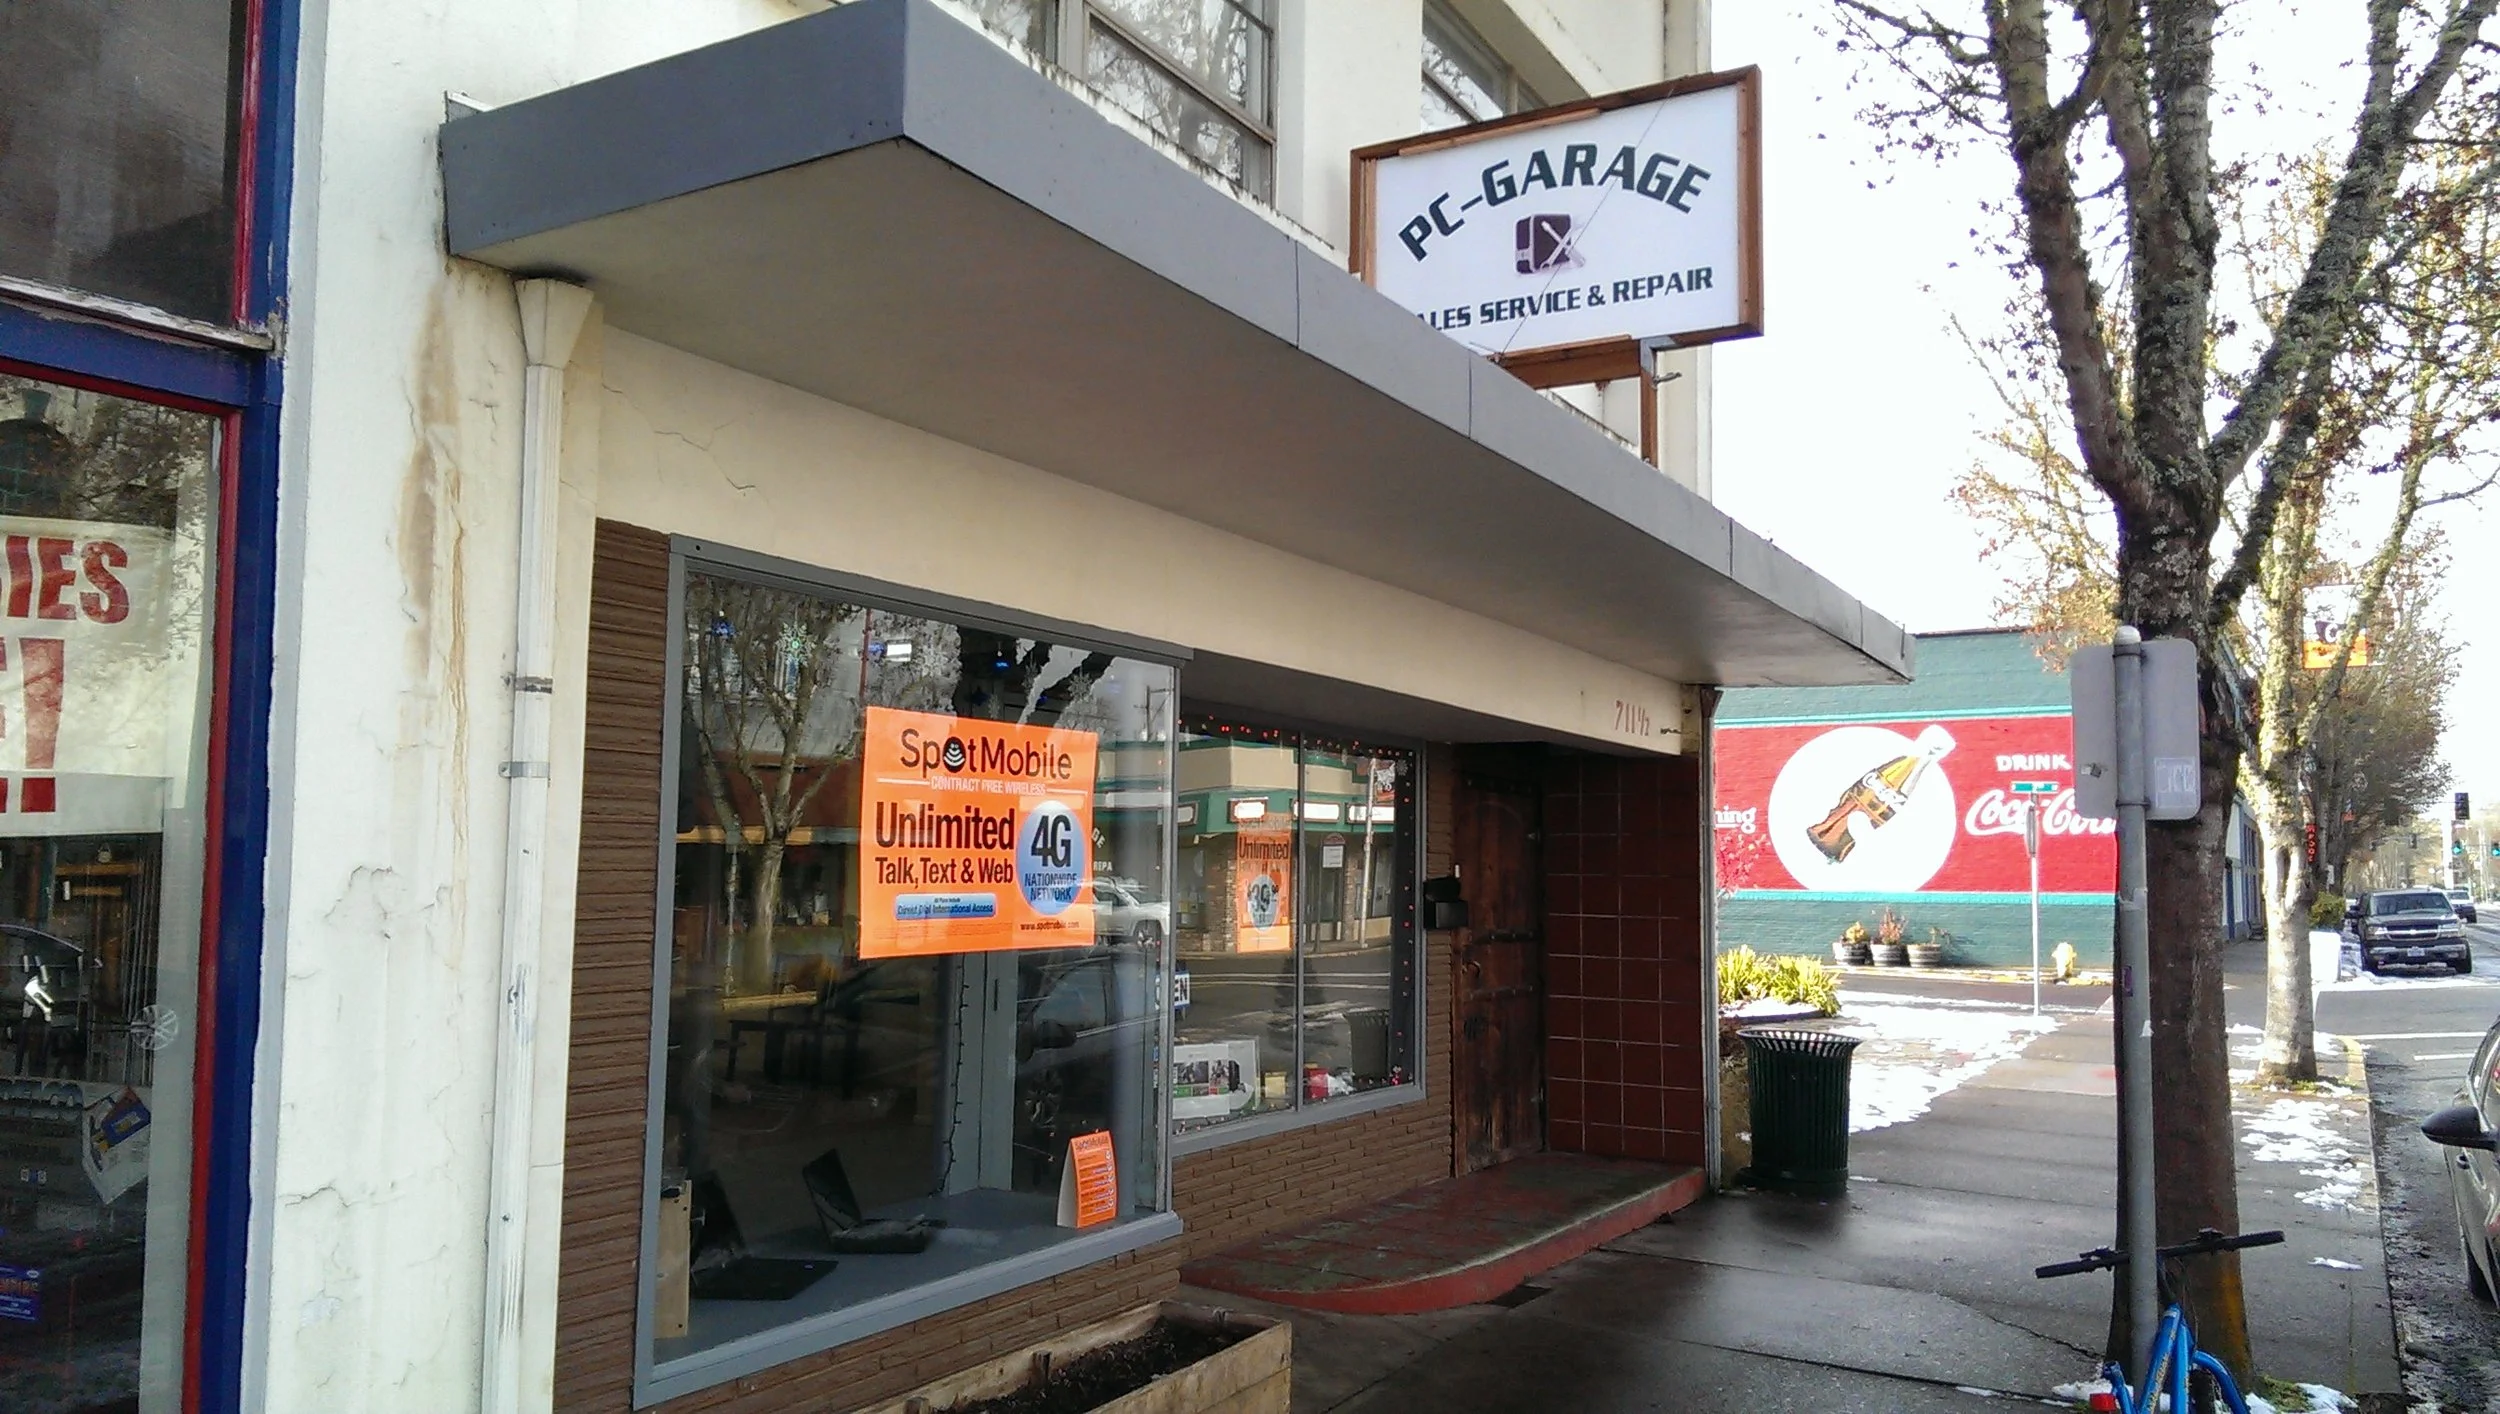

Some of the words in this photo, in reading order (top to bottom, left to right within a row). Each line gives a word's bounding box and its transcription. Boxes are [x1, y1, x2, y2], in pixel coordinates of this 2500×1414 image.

[1398, 142, 1713, 262] PC-GARAGE
[1416, 305, 1471, 331] LES
[1480, 287, 1581, 324] SERVICE
[1587, 284, 1606, 306] &
[1612, 266, 1714, 304] REPAIR
[0, 535, 130, 624] IES
[900, 727, 1073, 780] SpotMobile
[1996, 754, 2072, 772] DRINK
[931, 775, 980, 793] CONTRACT
[981, 778, 1004, 794] FREE
[1005, 781, 1047, 797] WIRELESS
[876, 801, 1016, 850] Unlimited
[1031, 815, 1072, 868] 4G
[1238, 836, 1290, 861] Unlimited
[875, 857, 919, 889] Talk,
[920, 857, 957, 884] Text
[961, 857, 975, 884] &
[978, 857, 1014, 884] Web
[1024, 872, 1078, 887] NATIONWIDE
[1030, 887, 1073, 901] NETWORK
